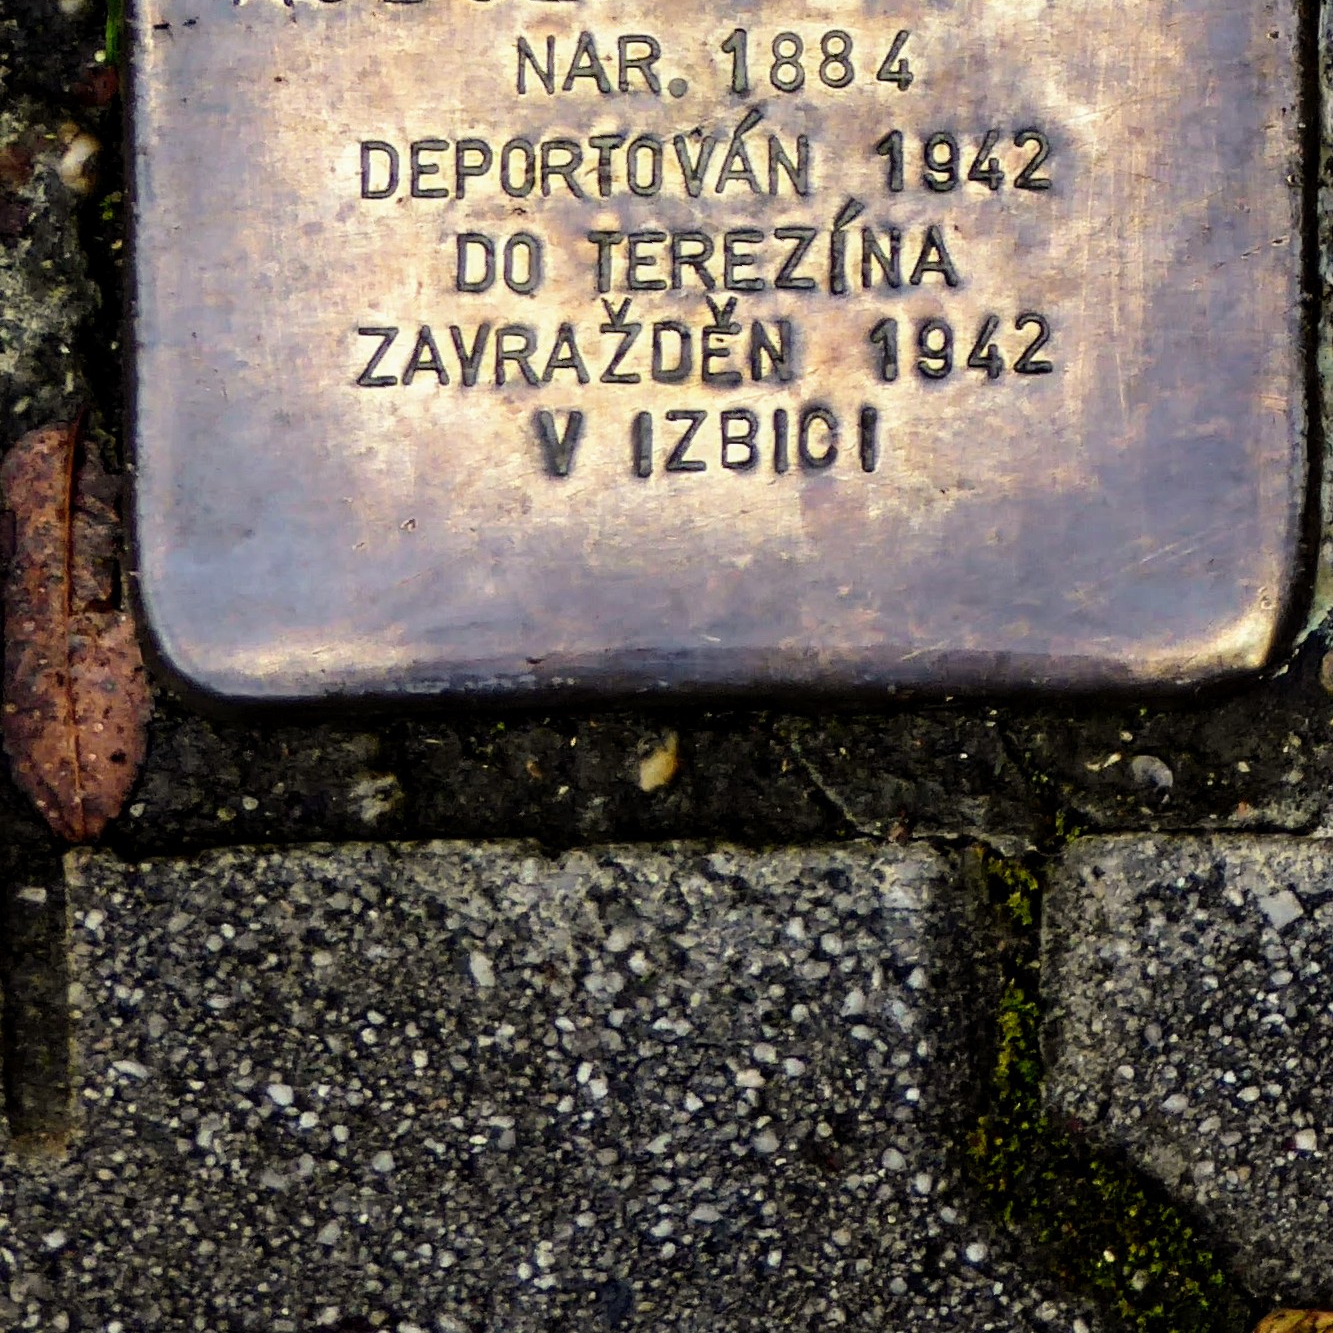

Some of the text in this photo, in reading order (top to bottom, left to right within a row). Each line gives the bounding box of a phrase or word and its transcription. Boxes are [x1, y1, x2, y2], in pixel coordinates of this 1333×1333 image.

[515, 28, 916, 98] NAR. 1884
[358, 107, 1055, 202] DEPORTOVÁN 1942
[455, 196, 960, 297] DO TEREZÍNA
[354, 295, 1056, 389] ZAVRAŽDĚN 1942
[531, 406, 878, 479] V IZBICI
